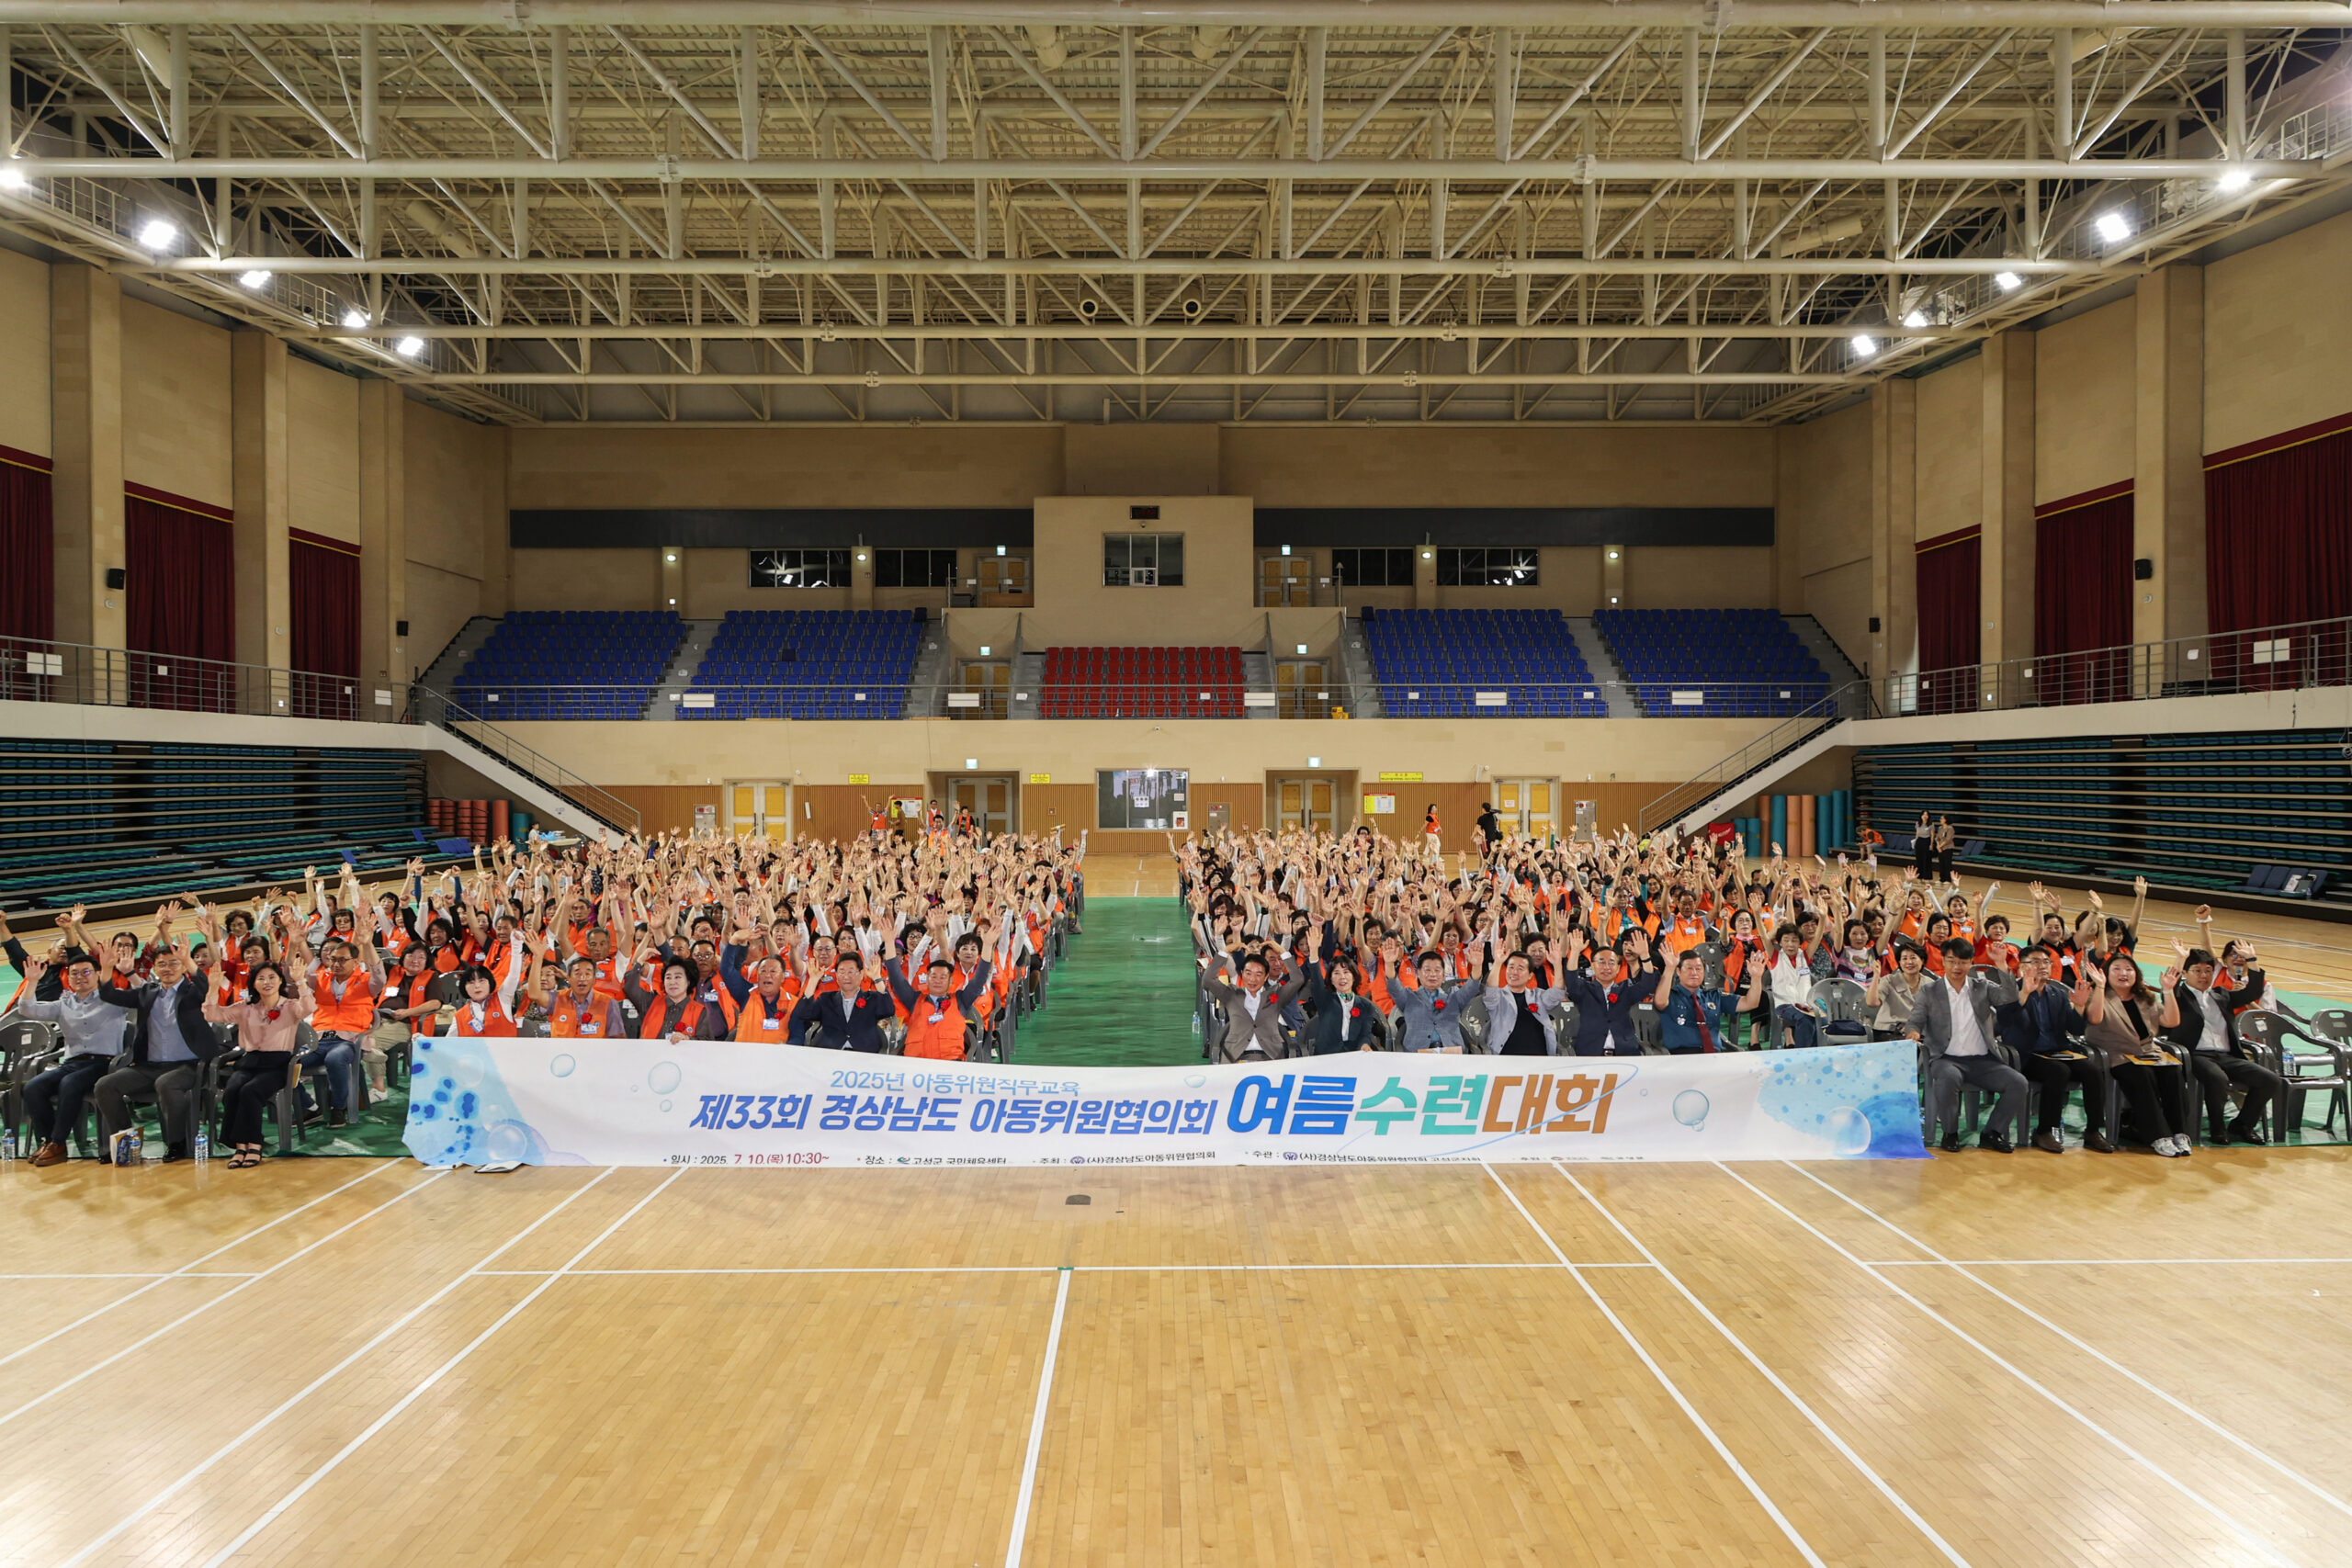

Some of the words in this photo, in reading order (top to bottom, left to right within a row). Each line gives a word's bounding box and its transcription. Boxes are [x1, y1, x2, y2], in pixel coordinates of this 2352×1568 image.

[830, 1070, 905, 1092] 2025년
[911, 1073, 1081, 1097] 아동위원직무교육
[689, 1094, 813, 1130] 제33회
[820, 1094, 963, 1132] 경상남도
[969, 1099, 1219, 1135] 아동위원협의회
[865, 1155, 885, 1165] 장소
